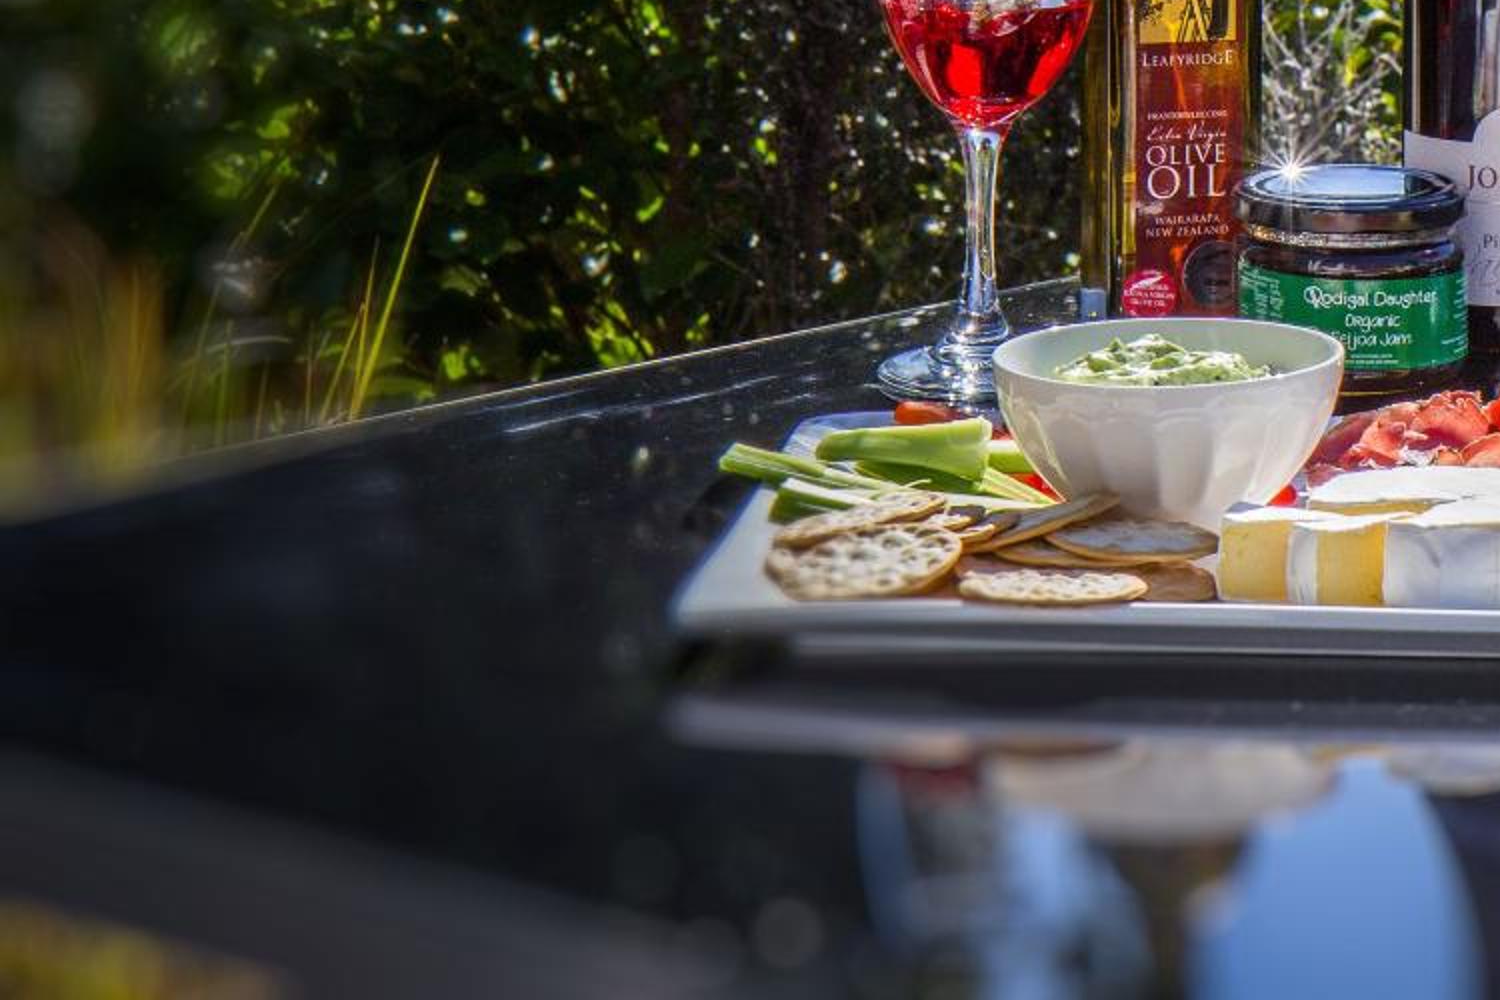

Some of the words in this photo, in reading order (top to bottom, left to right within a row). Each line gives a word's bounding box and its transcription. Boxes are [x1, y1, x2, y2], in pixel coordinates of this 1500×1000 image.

[1142, 49, 1233, 67] LEAFYRIDGE
[1145, 143, 1225, 167] OLIVE
[1147, 164, 1227, 200] OIL
[1155, 213, 1221, 226] WAIRARAPA
[1146, 227, 1173, 238] NEW
[1177, 224, 1229, 236] ZEALAND
[1374, 289, 1437, 310] Daughter
[1380, 332, 1412, 347] Jam
